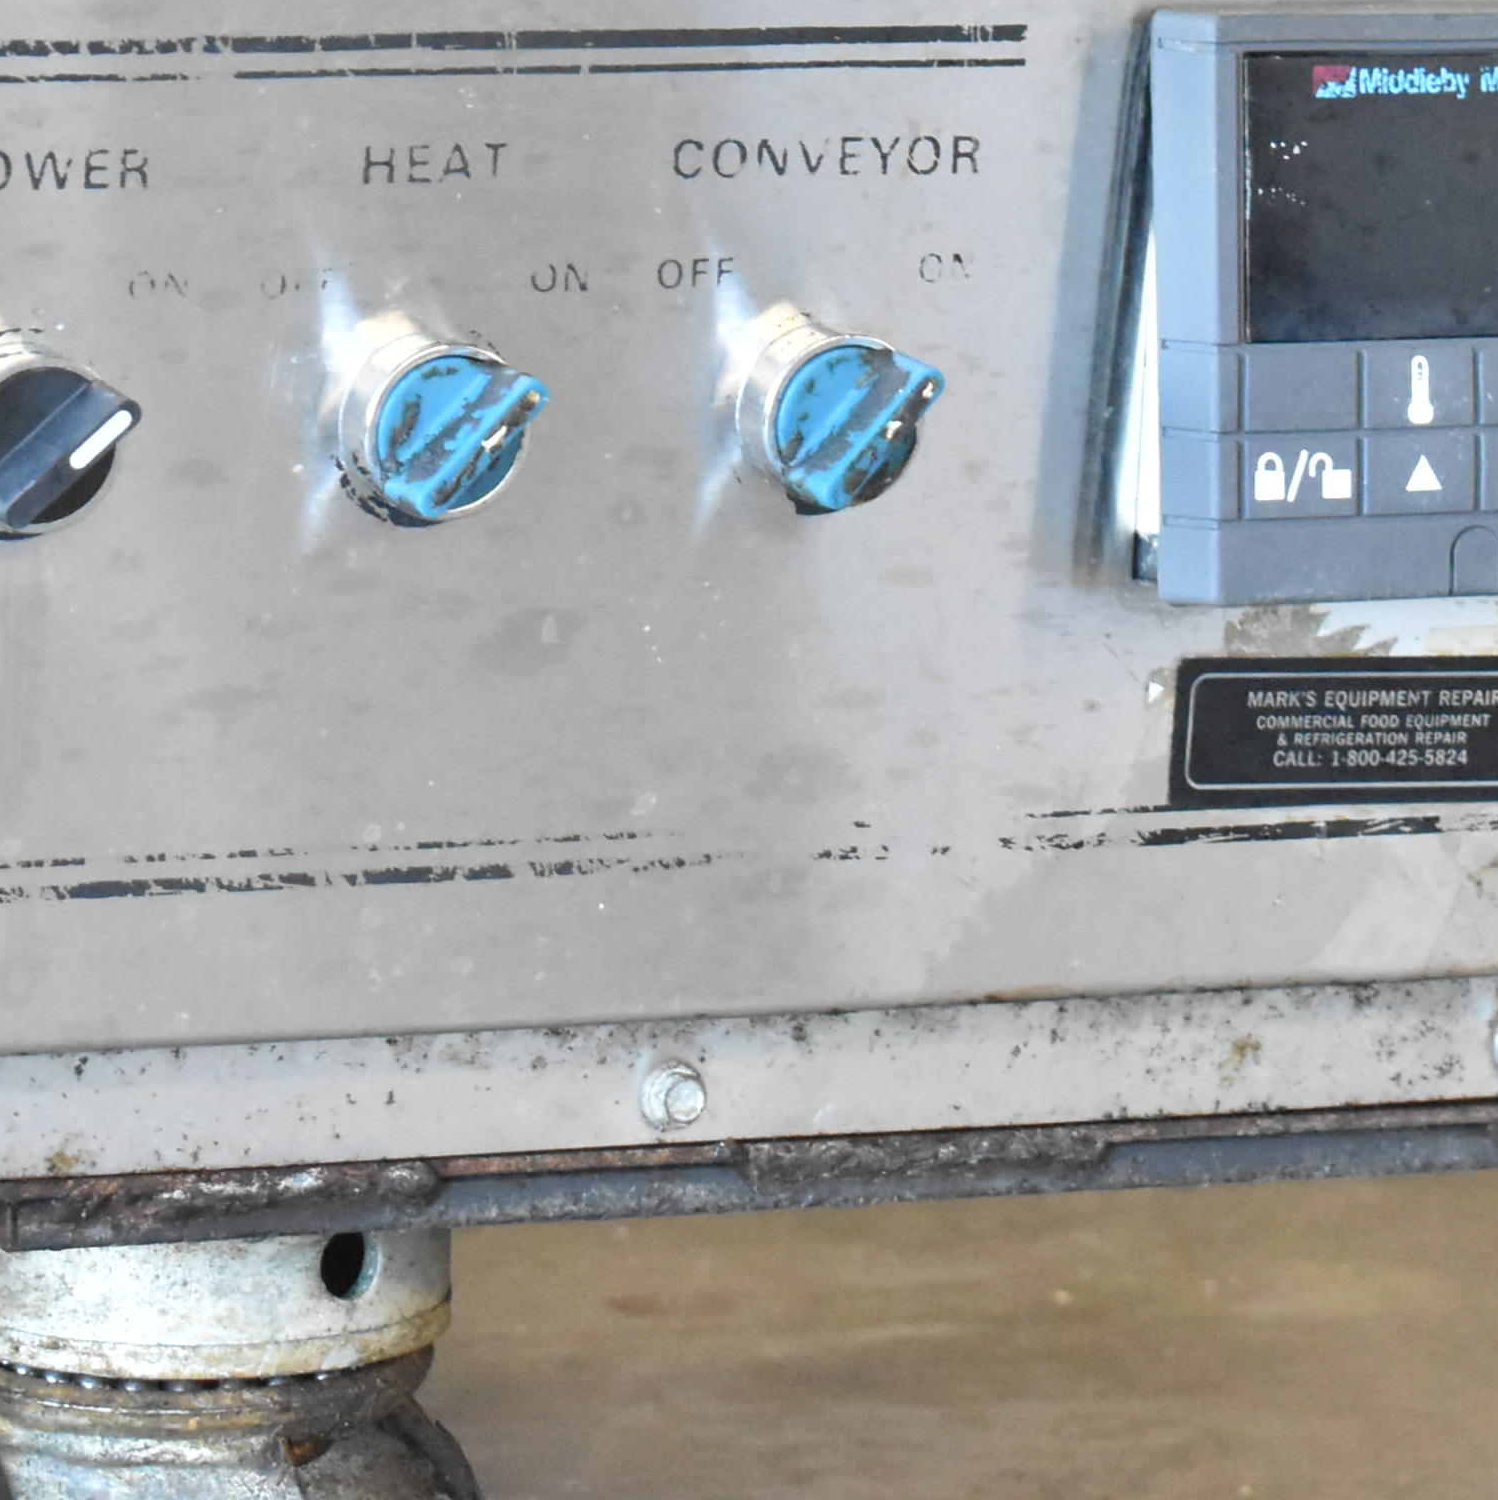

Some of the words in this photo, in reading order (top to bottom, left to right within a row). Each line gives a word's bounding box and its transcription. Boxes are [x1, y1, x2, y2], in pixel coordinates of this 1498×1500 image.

[1359, 65, 1471, 99] Middleby
[361, 141, 509, 185] HEAT
[671, 134, 983, 179] CONVEYOR
[530, 263, 590, 293] ON
[656, 256, 735, 289] OFF
[1247, 690, 1317, 709] MARK'S
[1324, 690, 1431, 712] EQUIPMENT
[1256, 714, 1355, 730] COMMERCIAL
[1360, 714, 1400, 729] FOOD
[1405, 713, 1491, 731] EQUIPMENT
[1277, 733, 1287, 747] &
[1293, 731, 1408, 747] REFRIGERATION
[1415, 731, 1468, 745] REPAIR
[1273, 750, 1322, 768] CALL:
[1331, 749, 1468, 767] 1-800-425-5824
